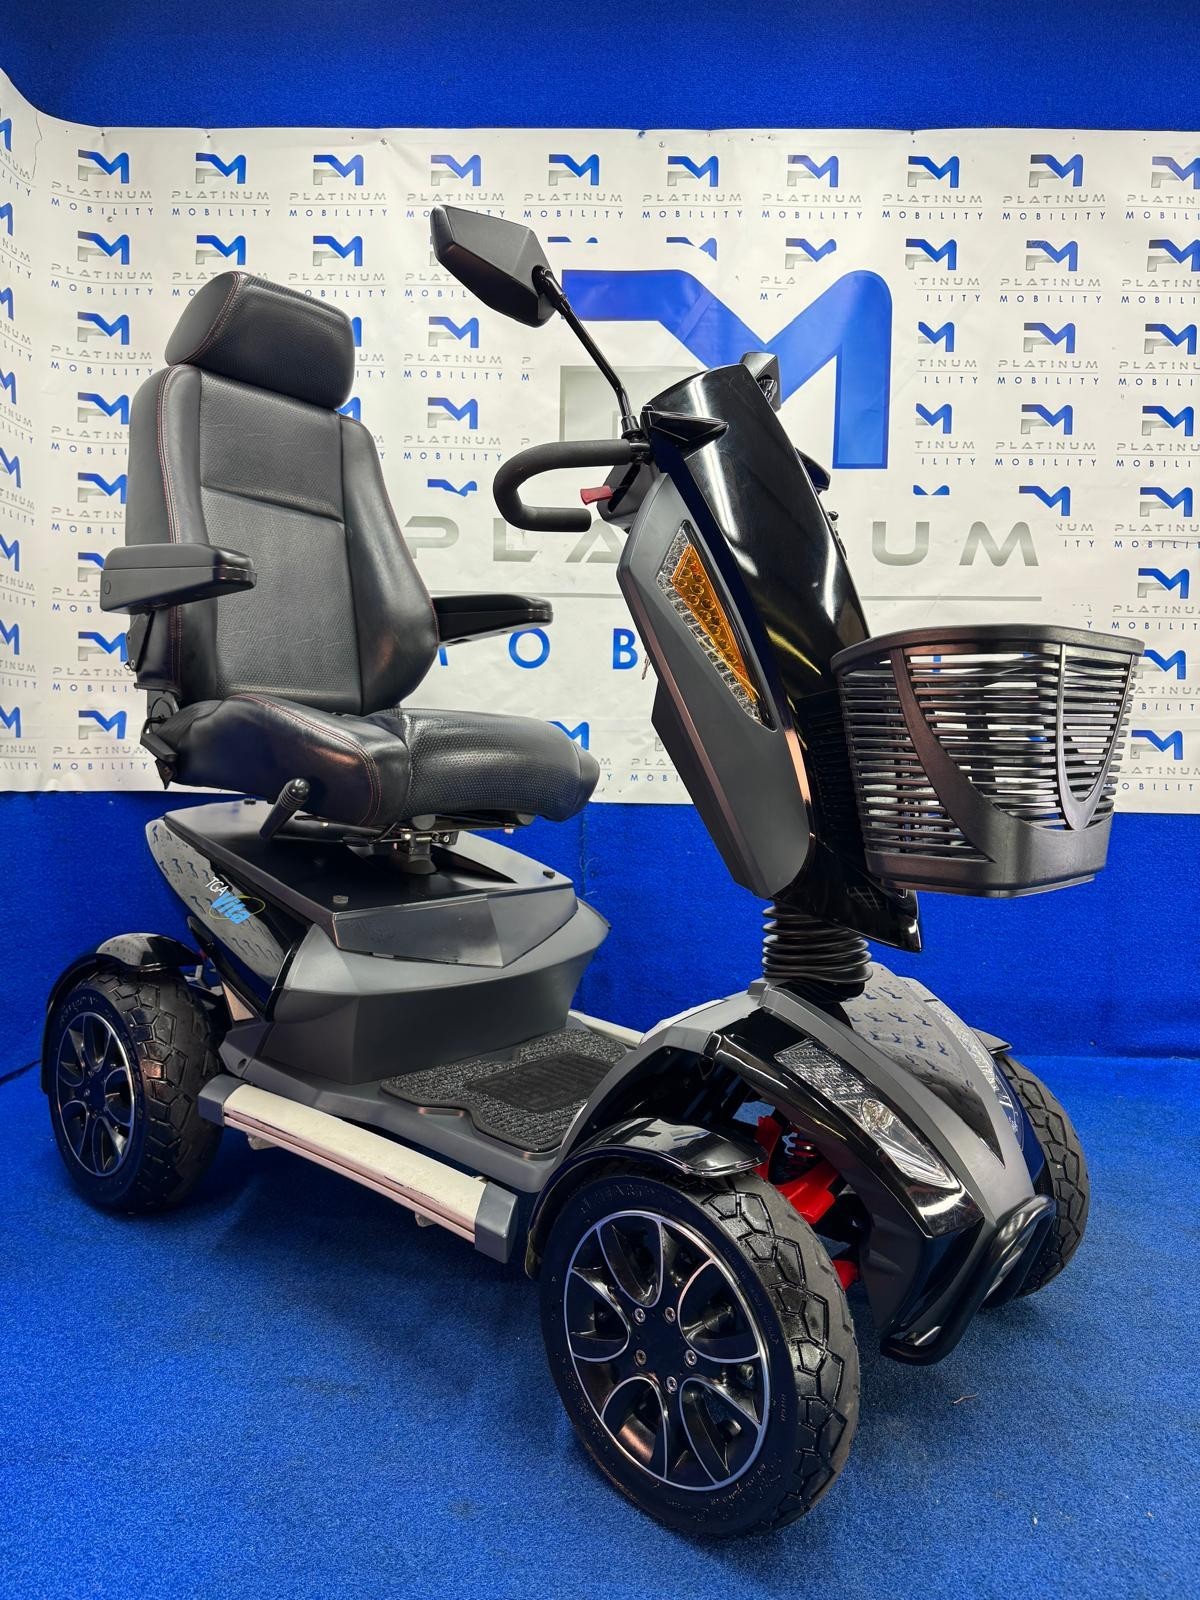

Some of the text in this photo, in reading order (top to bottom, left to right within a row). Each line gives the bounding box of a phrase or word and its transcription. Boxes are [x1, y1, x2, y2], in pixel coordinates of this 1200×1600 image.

[2, 169, 31, 196] LITY
[51, 181, 152, 199] PLATINUM
[171, 190, 269, 200] PLATINUM
[289, 192, 386, 201] PLATINUM
[407, 193, 505, 202] PLATINUM
[523, 193, 623, 202] PLATINUM
[642, 193, 742, 202] PLATINUM
[761, 193, 862, 203] PLATINUM
[882, 193, 983, 203] PLATINUM
[1002, 194, 1106, 204] PLATINUM
[1126, 194, 1195, 204] PLATIN
[51, 198, 153, 215] MOBILITY
[172, 208, 271, 217] MOBILITY
[289, 209, 388, 218] MOBILITY
[523, 210, 624, 219] MOBILITY
[642, 210, 743, 219] MOBILITY
[761, 210, 863, 220] MOBILITY
[882, 210, 983, 220] MOBILITY
[1002, 211, 1106, 221] MOBILITY
[1125, 211, 1200, 221] MOBILI
[1, 255, 32, 279] LITY
[51, 263, 153, 280] PLATINUM
[288, 272, 385, 281] PLATINUM
[405, 272, 451, 281] PLAT
[51, 280, 153, 295] MOBILITY
[999, 278, 1101, 287] PLATINUM
[304, 289, 386, 298] OBILITY
[405, 289, 467, 298] MOBIL
[999, 294, 1102, 303] MOBILITY
[1121, 296, 1196, 304] MOBILI
[4, 340, 32, 362] LITY
[51, 345, 152, 360] PLATINUM
[403, 353, 502, 364] PLATINUM
[51, 361, 152, 376] MOBILITY
[998, 359, 1098, 369] PLATINUM
[1119, 361, 1200, 370] PLATINU
[403, 370, 503, 380] MOBILITY
[997, 376, 1099, 385] MOBILITY
[1118, 378, 1193, 387] MOBILI
[2, 421, 33, 444] ILITY
[51, 426, 123, 439] PLATIN
[403, 435, 501, 445] PLATINUM
[51, 442, 127, 456] MOBILI
[995, 441, 1096, 450] PLATINUM
[1116, 443, 1200, 451] PLATINU
[403, 451, 502, 461] MOBILITY
[995, 458, 1096, 467] MOBILITY
[1116, 459, 1191, 468] MOBILI
[2, 506, 34, 526] ILITY
[51, 507, 122, 518] PLATIN
[51, 523, 116, 535] MOBIL
[1114, 524, 1200, 532] PLATINU
[402, 515, 1040, 567] PLAUM
[1114, 540, 1200, 549] MOBILI
[52, 587, 100, 597] PLAT
[2, 592, 35, 607] ILITY
[1112, 605, 1195, 614] PLATINU
[1111, 621, 1200, 631] MOBILIT
[1, 677, 36, 688] ILITY
[53, 683, 127, 692] MOBILI
[1135, 686, 1200, 695] ATINU
[1141, 702, 1195, 711] BILIT
[3, 761, 38, 770] ILITY
[630, 774, 679, 782] MOBI
[1121, 782, 1193, 791] OBILIT
[205, 876, 230, 896] TGA
